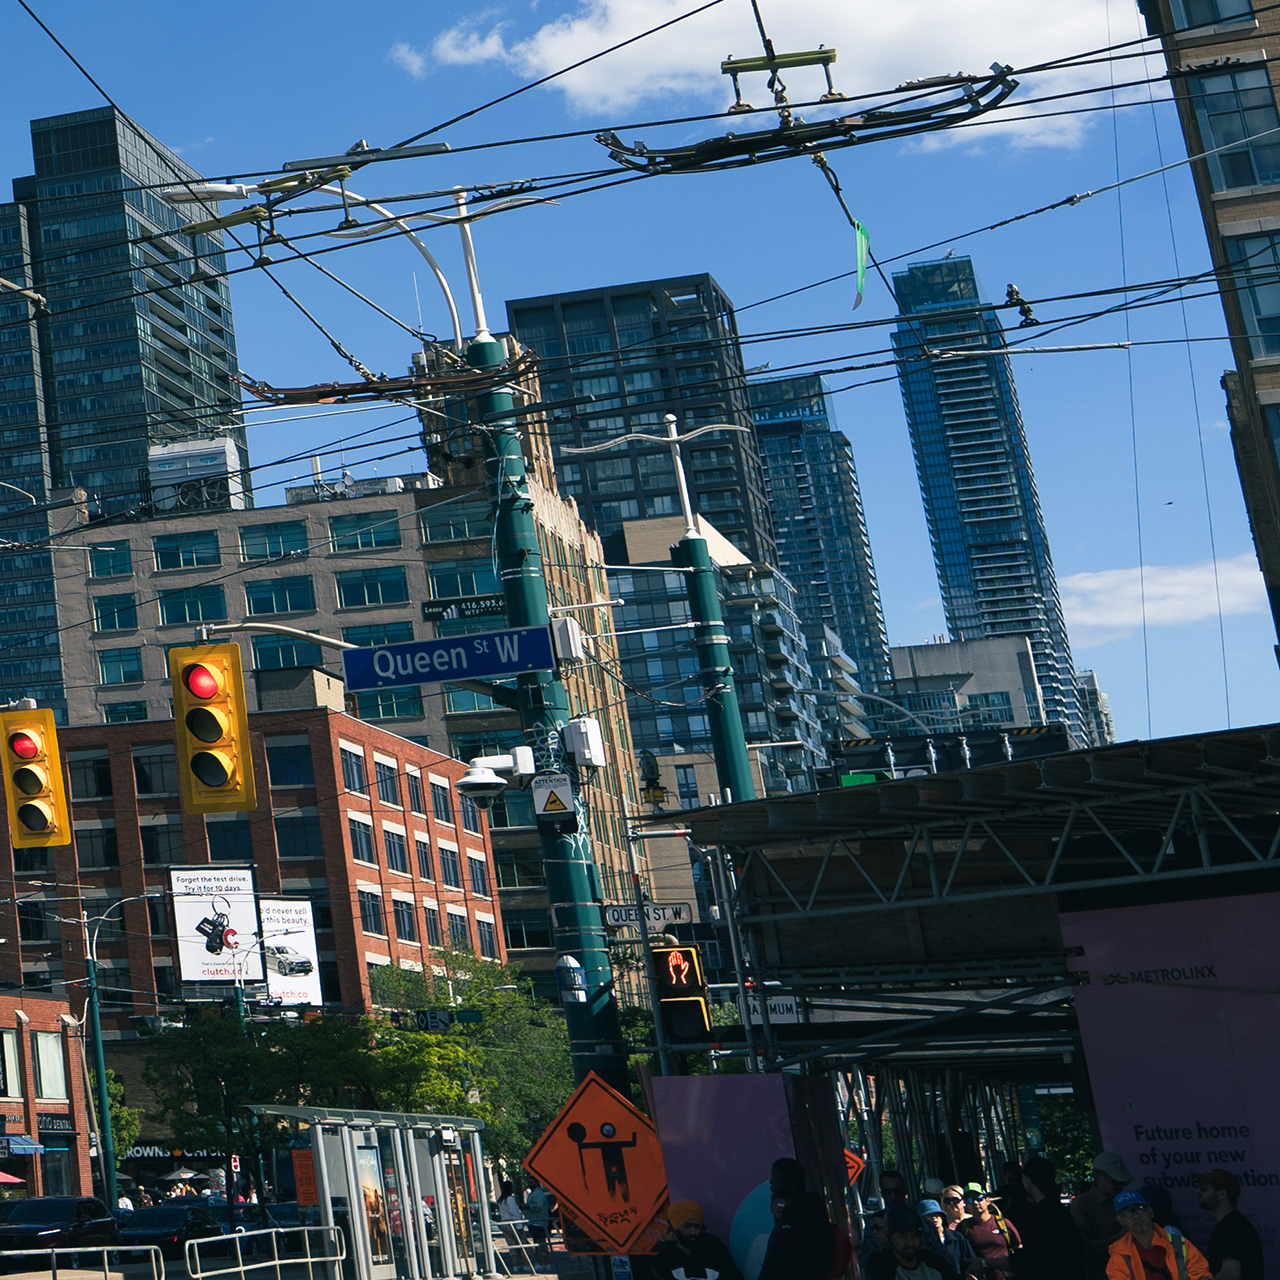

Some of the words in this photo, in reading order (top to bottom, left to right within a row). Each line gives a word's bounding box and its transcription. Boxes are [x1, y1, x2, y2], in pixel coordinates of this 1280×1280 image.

[461, 600, 505, 609] 416.593.6
[373, 646, 468, 680] Queen
[473, 639, 490, 654] St
[494, 634, 519, 663] W
[176, 876, 200, 884] Forget
[281, 917, 310, 925] beauty.
[612, 908, 650, 922] QUEEN
[653, 907, 670, 921] ST.
[672, 906, 684, 920] W.
[1130, 965, 1217, 983] METROLINX
[53, 1120, 72, 1130] DENTAL
[1133, 1124, 1193, 1141] Future
[1196, 1121, 1250, 1139] home
[1139, 1147, 1157, 1165] of
[1161, 1151, 1202, 1169] your
[1206, 1150, 1246, 1163] new
[1143, 1171, 1202, 1188] subwa
[1234, 1169, 1280, 1187] ation
